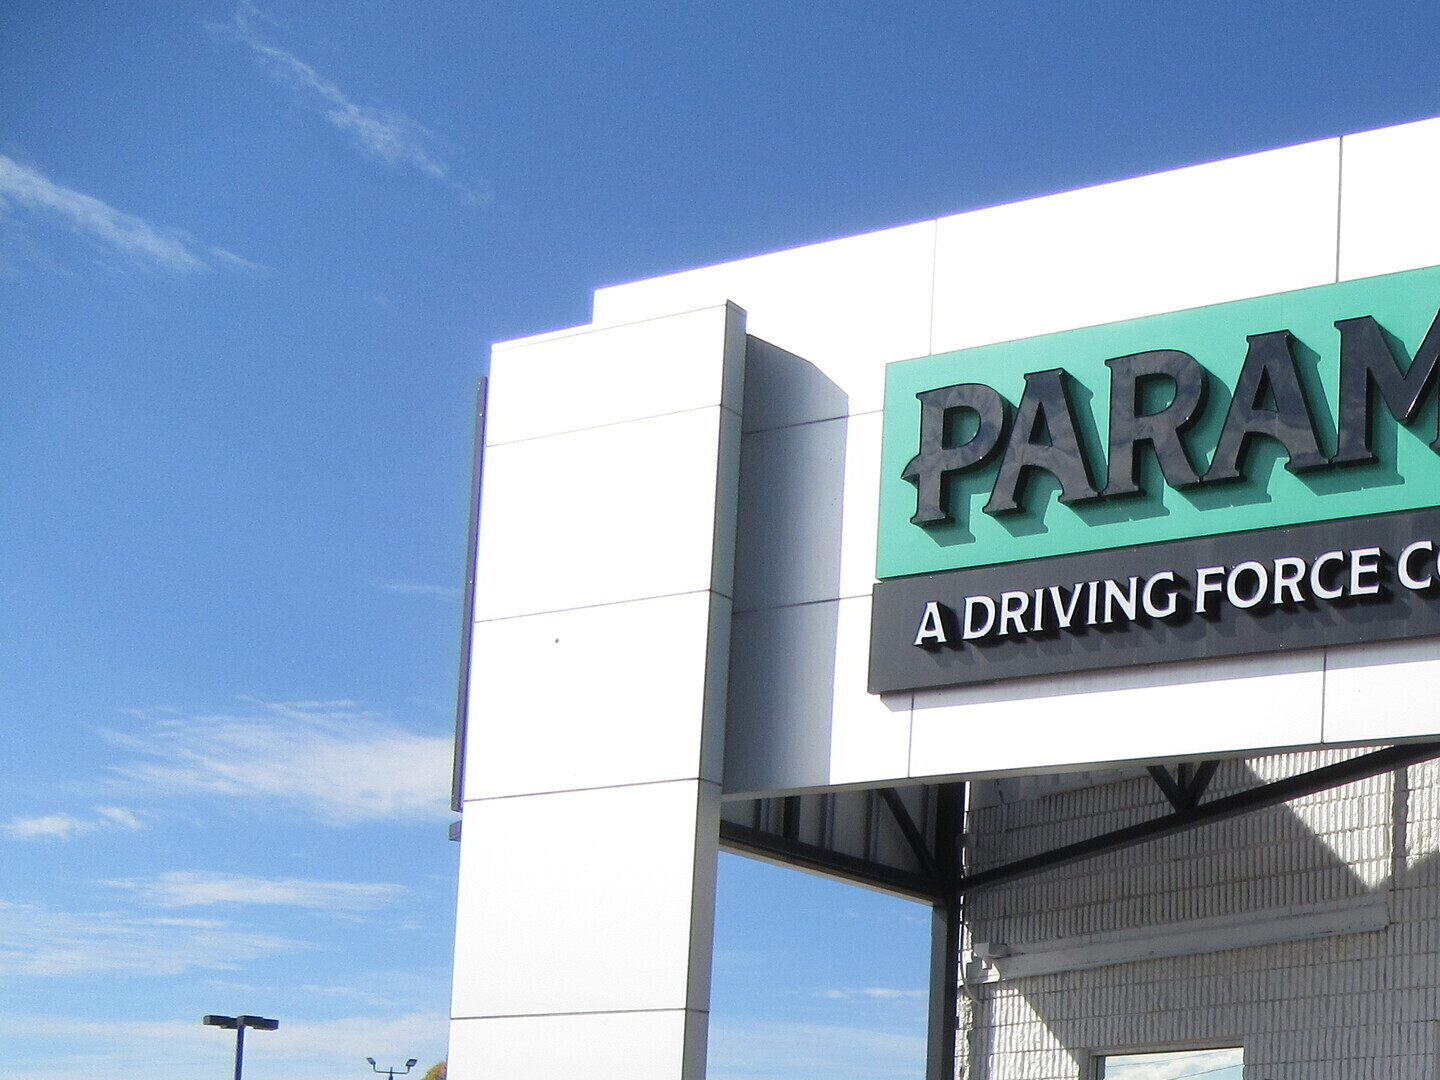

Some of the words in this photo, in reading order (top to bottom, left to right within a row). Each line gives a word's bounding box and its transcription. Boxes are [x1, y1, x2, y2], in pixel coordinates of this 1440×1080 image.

[914, 600, 947, 646] A
[962, 571, 1178, 643] DRIVING
[1194, 546, 1381, 616] FORCE
